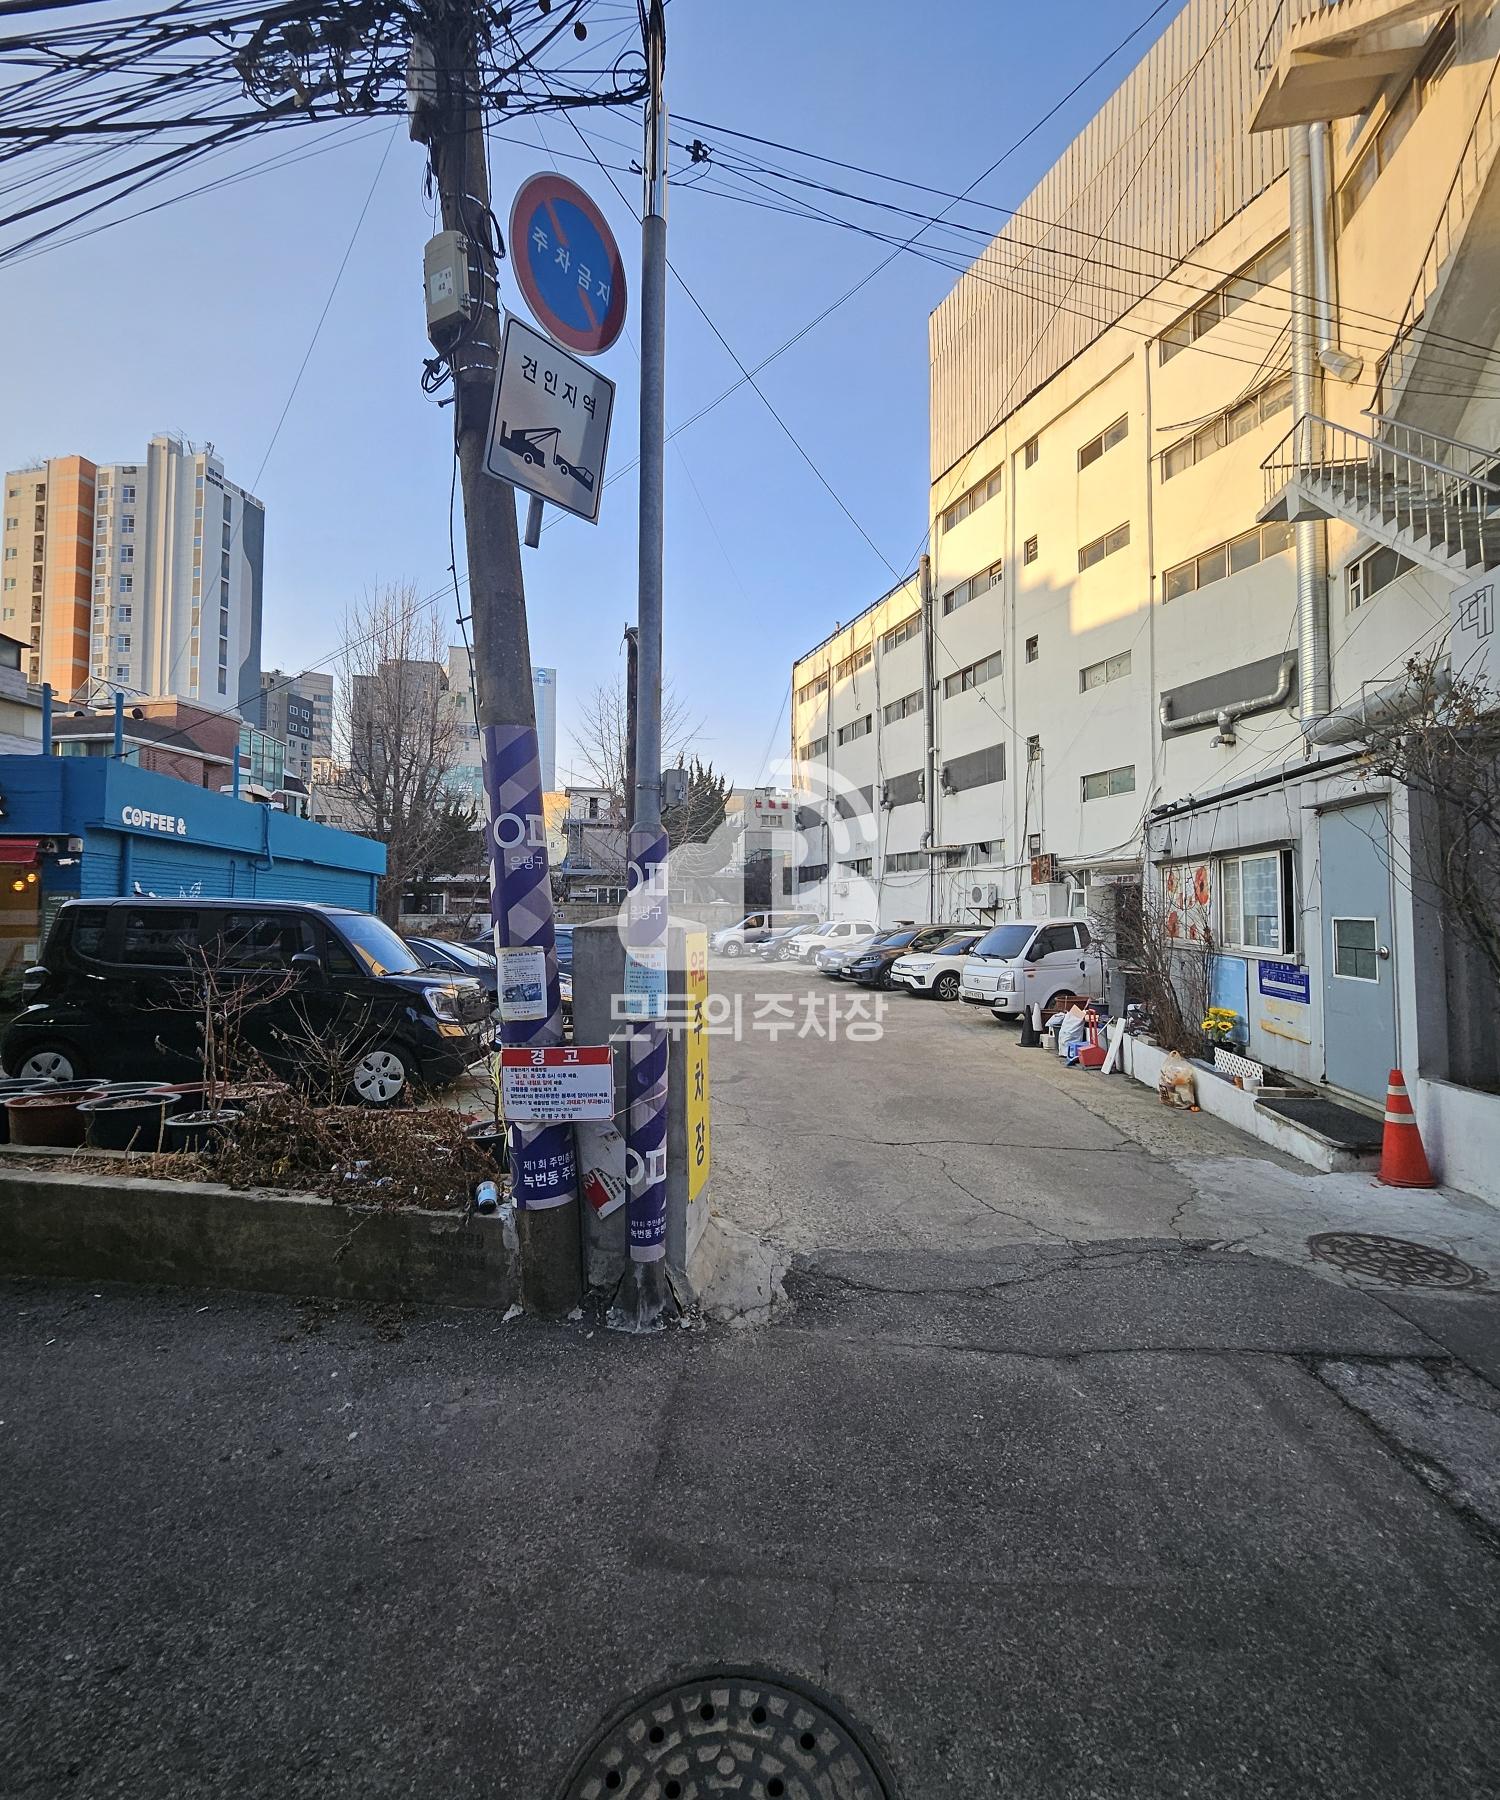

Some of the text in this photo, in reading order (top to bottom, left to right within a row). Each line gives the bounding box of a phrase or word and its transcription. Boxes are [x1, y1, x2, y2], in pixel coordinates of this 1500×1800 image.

[532, 226, 610, 306] 주차금지
[521, 355, 596, 420] 견인지역
[122, 806, 186, 835] COFFEE &
[511, 856, 544, 870] 은평구
[690, 951, 705, 987] 유료
[530, 1049, 580, 1065] 경고
[523, 1159, 547, 1170] 제1회
[523, 1170, 559, 1188] 녹번동
[630, 1228, 652, 1238] 녹번동
